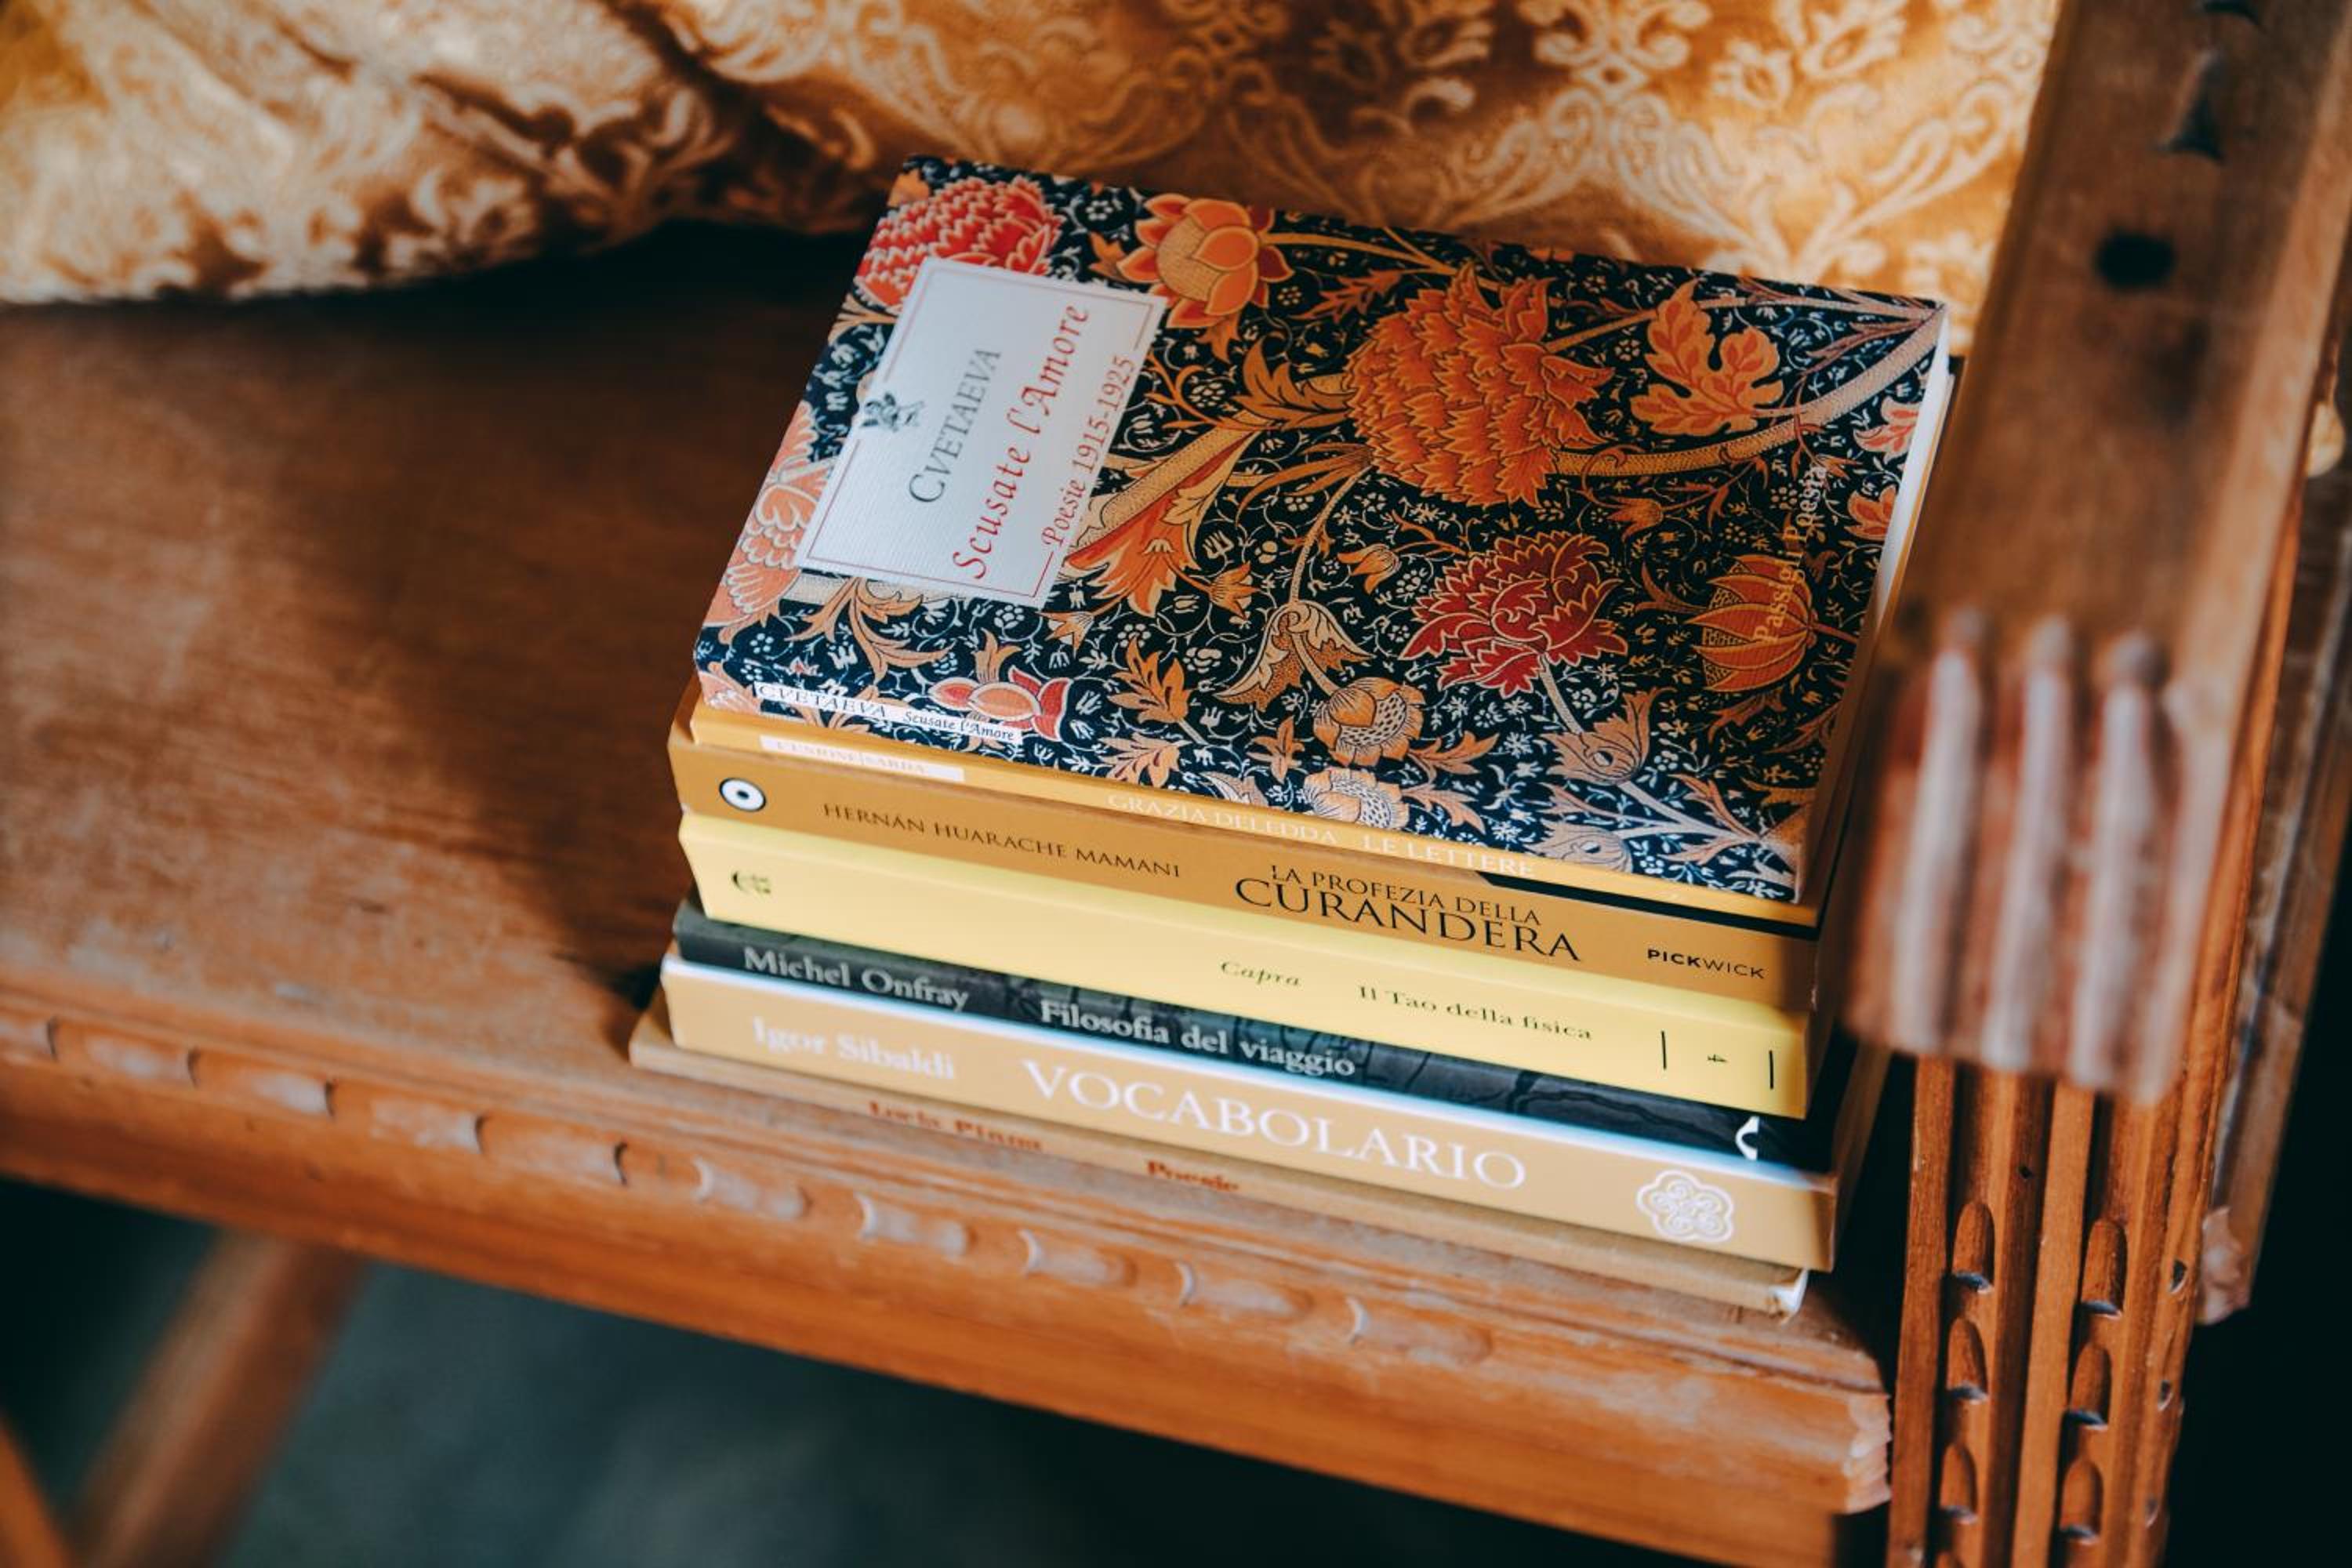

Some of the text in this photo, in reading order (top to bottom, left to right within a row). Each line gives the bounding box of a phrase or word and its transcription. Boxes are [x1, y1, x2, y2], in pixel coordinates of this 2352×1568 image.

[909, 347, 1000, 503] CVETAEVA
[953, 306, 1090, 580] Scusate l'Amore
[1040, 356, 1135, 547] Poesie 1915-1925
[1753, 465, 1828, 643] Passigli Poesia
[758, 685, 1014, 741] CVETAEVA Scusate l'Amore
[822, 803, 1180, 877] HERNÁN HUARACHE MAMANI
[1107, 794, 1534, 877] GRAZIA DELEDDA LE LETTERE
[1235, 877, 1581, 962] CURANDERA
[1271, 865, 1540, 926] LA PROFEZIA DELLA
[743, 946, 969, 1013] Michel Onfray
[1220, 959, 1301, 988] Capra
[1648, 948, 1766, 978] PICKWICK
[753, 1017, 956, 1080] Igor Sibaldi
[1040, 1000, 1356, 1077] Filosofia del viaggio
[1357, 984, 1592, 1040] Il Tao della fisica
[1023, 1058, 1527, 1189] VOCABOLARIO
